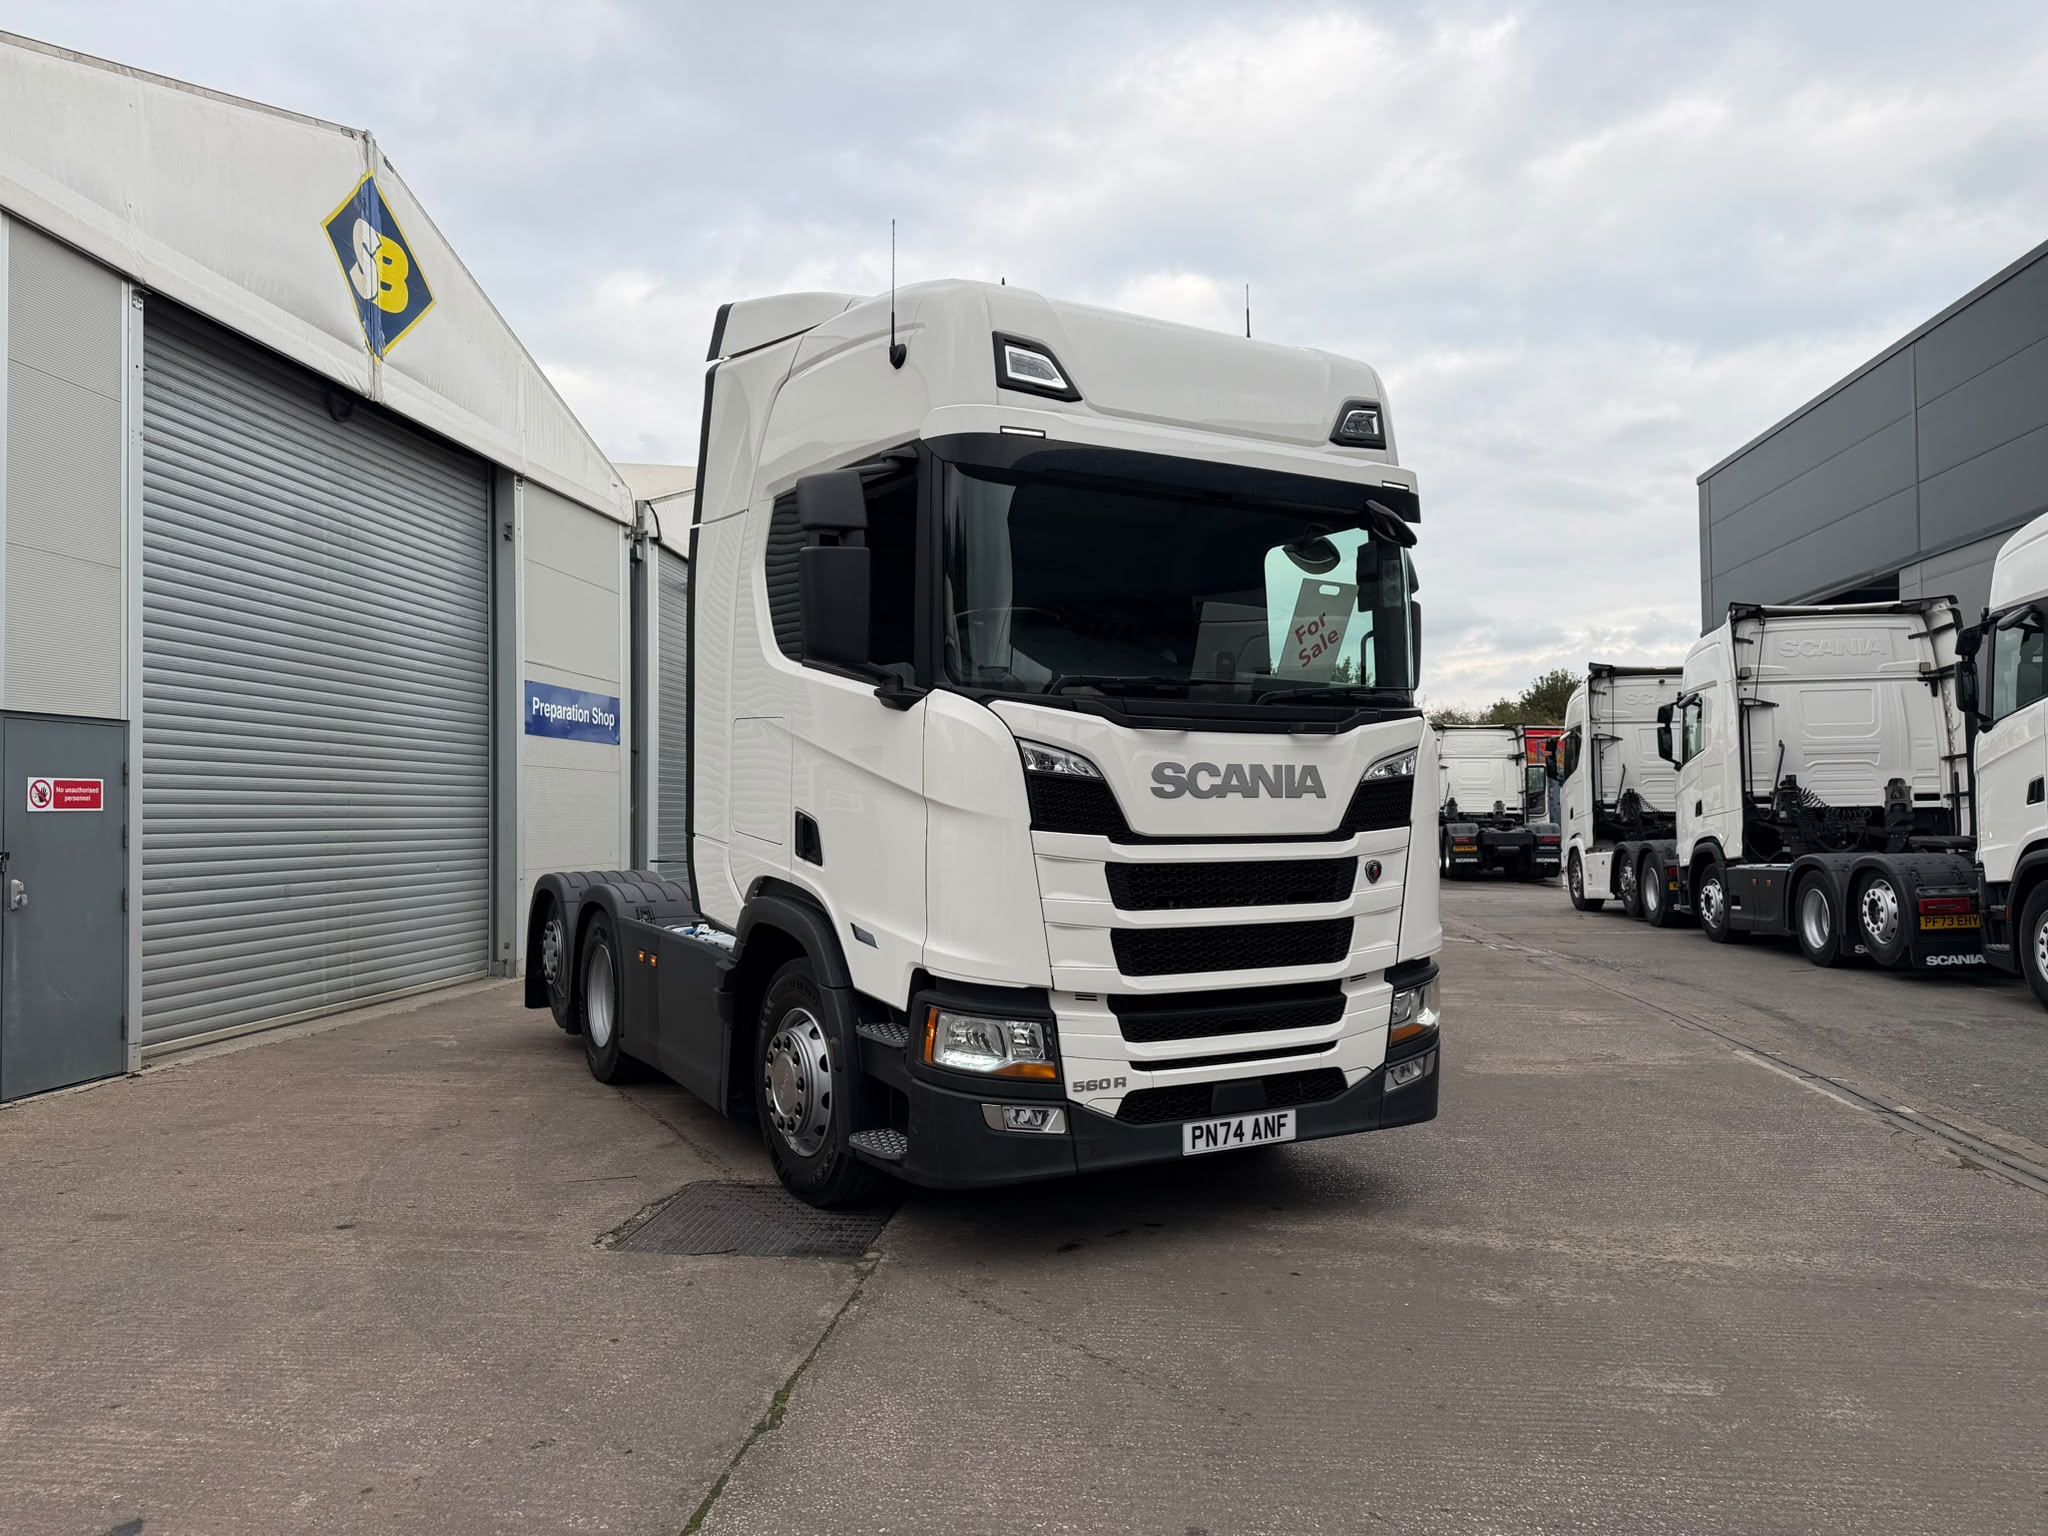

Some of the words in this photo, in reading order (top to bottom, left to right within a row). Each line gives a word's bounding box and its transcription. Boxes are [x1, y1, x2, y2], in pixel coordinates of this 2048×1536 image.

[1294, 612, 1327, 645] For
[1298, 630, 1339, 667] Sale
[1780, 639, 1888, 657] SCANIA
[532, 696, 590, 722] Preparation
[592, 707, 615, 731] Shop
[65, 786, 99, 794] unauthorised
[1150, 761, 1327, 799] SCANIA
[1925, 915, 1954, 928] PF73
[1957, 914, 1979, 927] EHY
[1926, 954, 1987, 966] SCANIA
[1072, 1079, 1111, 1092] 560
[1113, 1076, 1127, 1089] R
[1192, 1119, 1245, 1149] PN74
[1251, 1113, 1288, 1141] ANF
